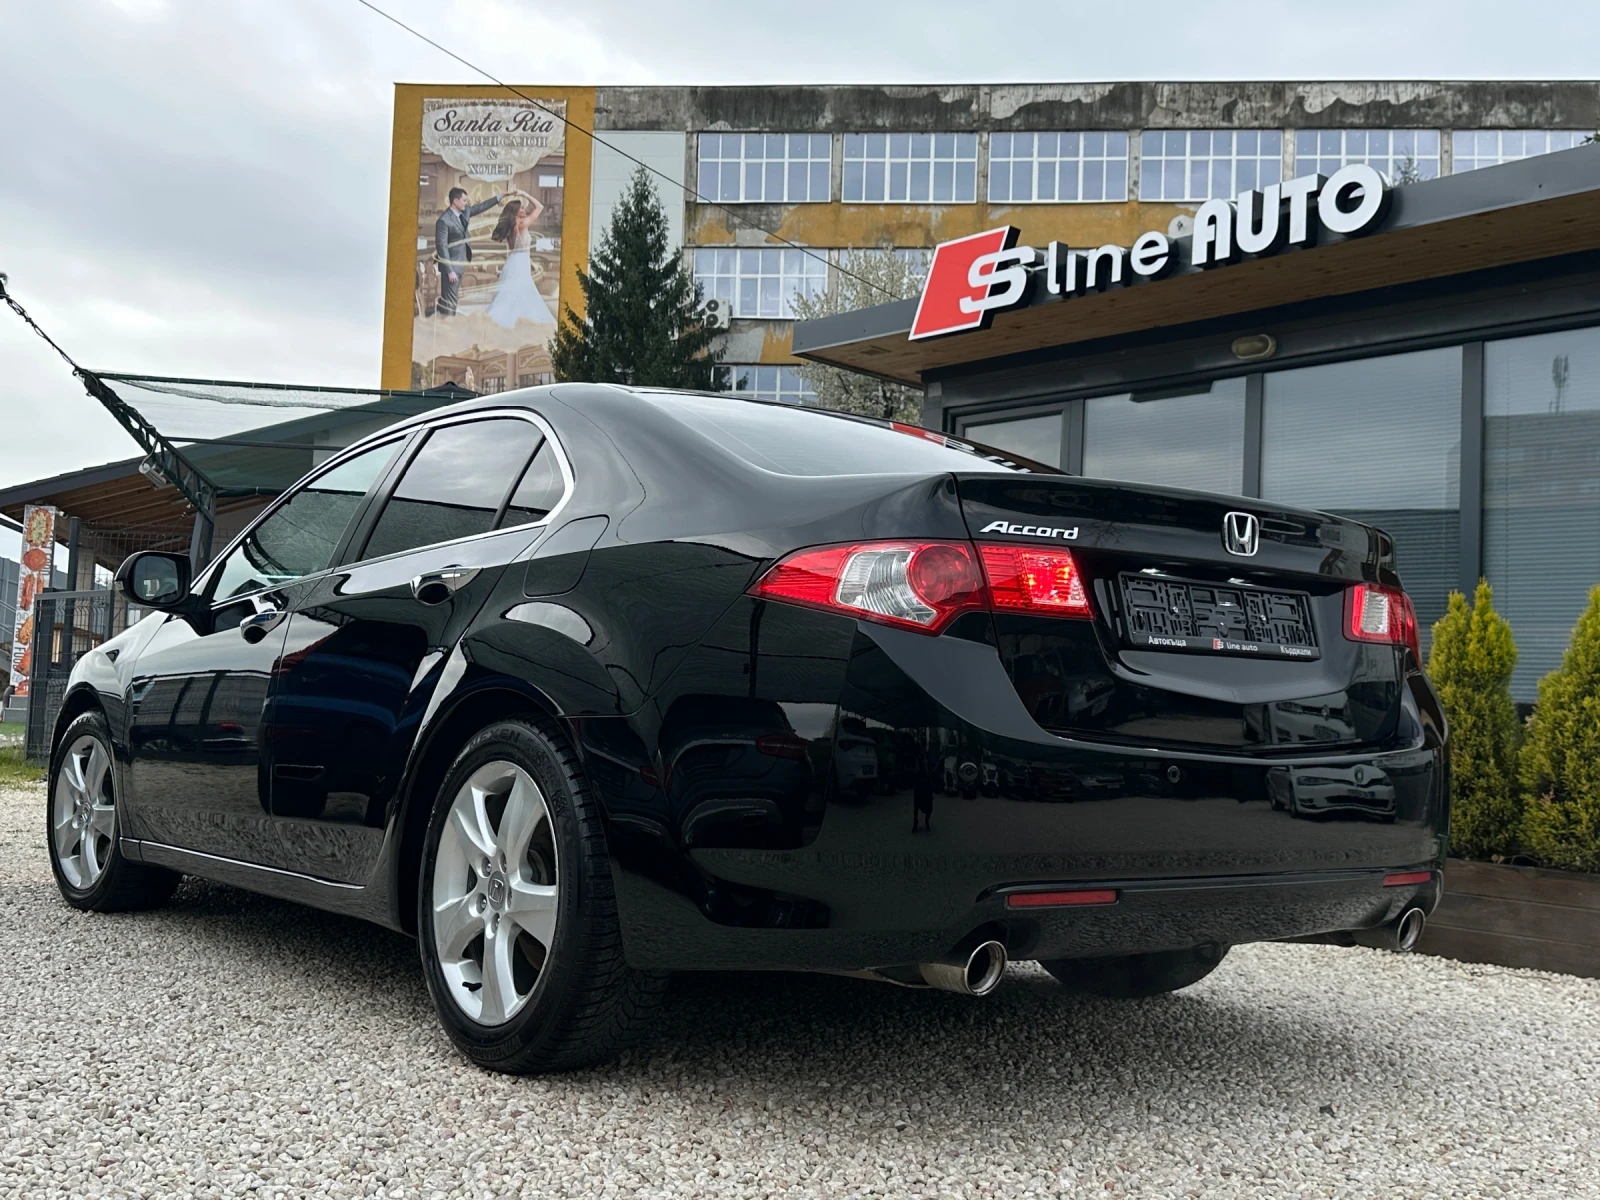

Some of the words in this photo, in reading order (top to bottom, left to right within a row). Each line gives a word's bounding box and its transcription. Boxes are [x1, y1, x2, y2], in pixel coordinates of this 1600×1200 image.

[434, 110, 502, 133] Santa
[505, 110, 554, 133] Ria
[1192, 164, 1384, 266] AUTO
[978, 520, 1079, 540] Accord
[1148, 636, 1187, 647] Автокъща
[1226, 642, 1240, 650] line
